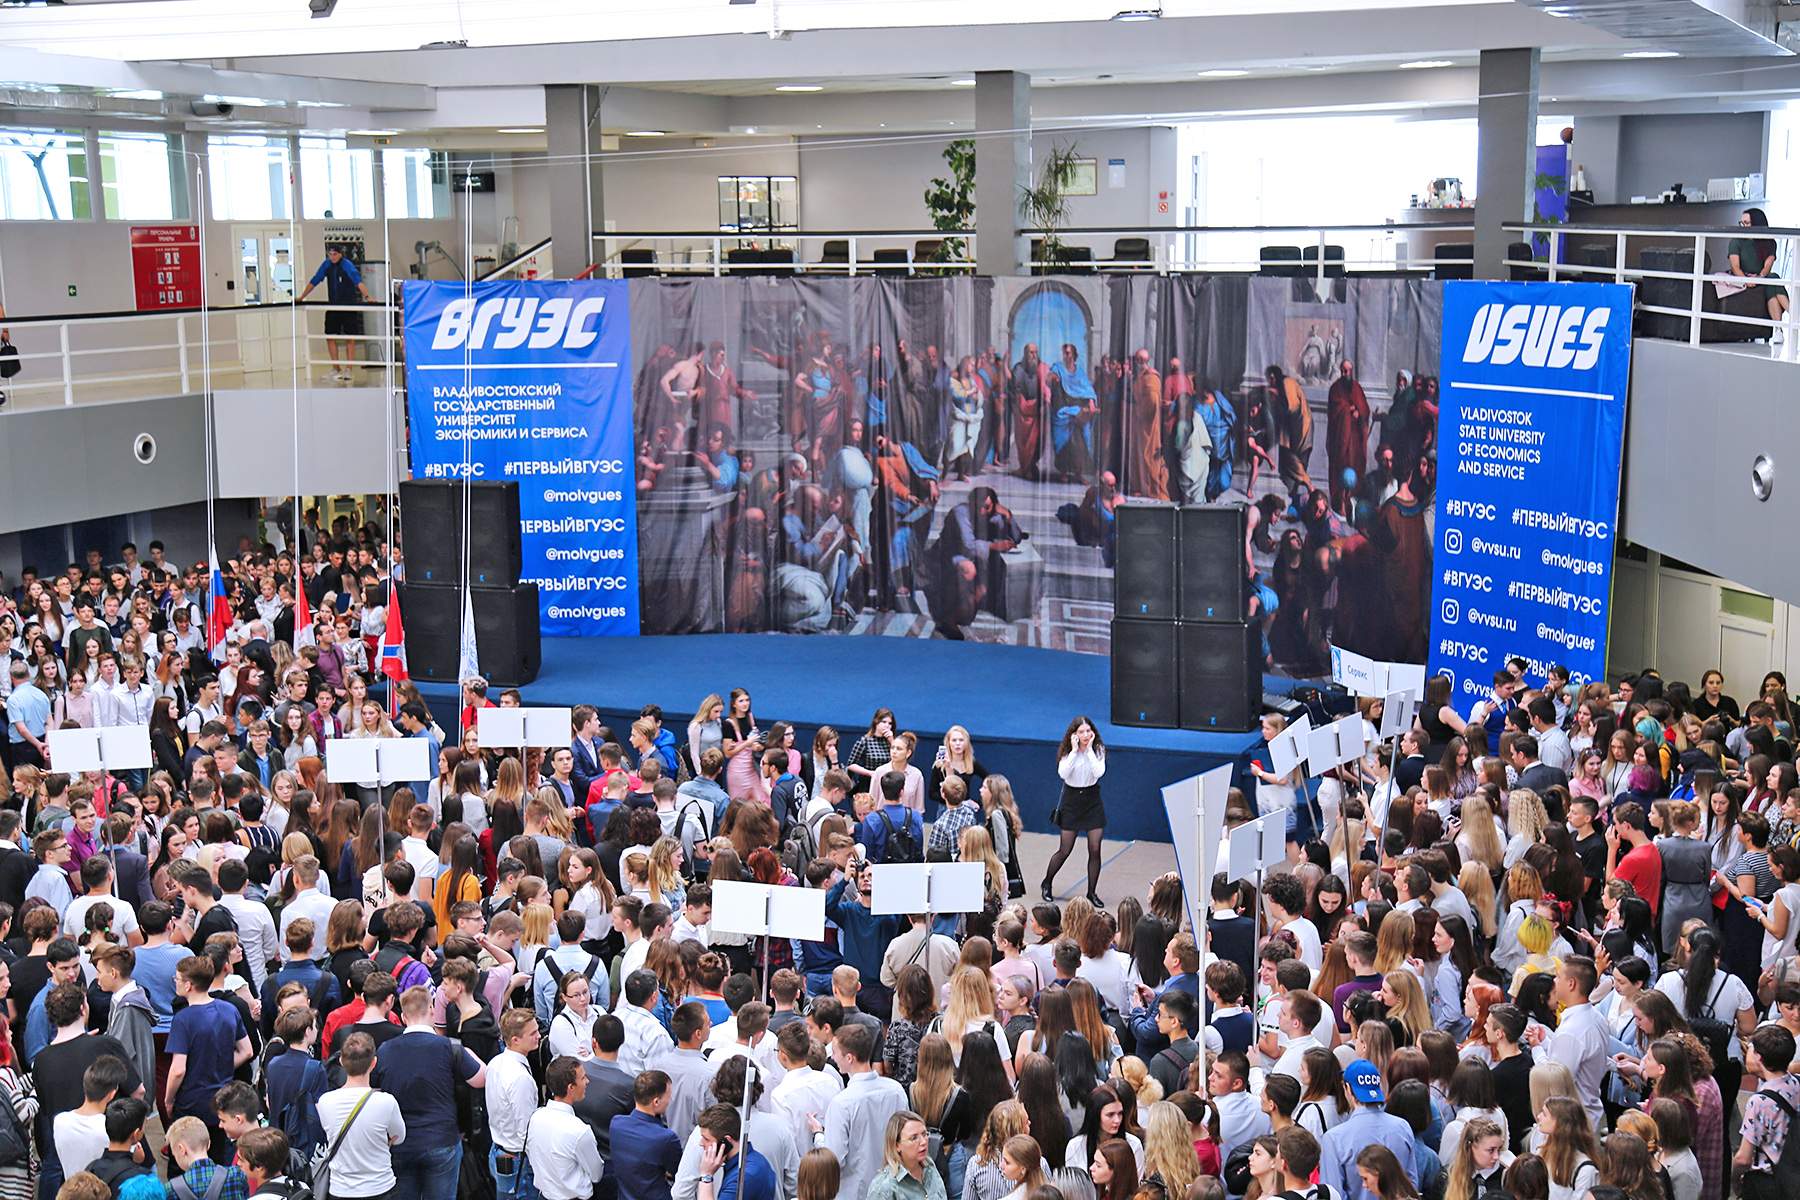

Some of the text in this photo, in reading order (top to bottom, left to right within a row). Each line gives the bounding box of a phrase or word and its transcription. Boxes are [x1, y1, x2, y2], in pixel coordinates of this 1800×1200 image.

[431, 297, 605, 350] ВГУЭС
[1462, 303, 1611, 371] USUES
[433, 383, 562, 398] ВЛАДИВОСТОКСКИЙ
[434, 398, 555, 413] ГОСУДАРСТВЕННЫЙ
[435, 414, 516, 426] УНИВЕРСИТЕТ
[1460, 406, 1532, 426] VLADIVOSTOK
[435, 427, 588, 440] ЭКОНОМИКИ И СЕРВИСА
[1459, 425, 1546, 446] STATE UNIVERSITY
[1458, 442, 1541, 464] OF ECONOMICS
[425, 458, 623, 477] #ВГУЭС #ПЕРВЫЙВГУЭС
[1458, 460, 1525, 480] AND SERVICE
[543, 489, 623, 504] @molvgues
[1446, 499, 1608, 540] #ВГУЭС #ПЕРВЫЙВГУЭС
[546, 548, 625, 562] @molvgues
[1471, 537, 1521, 559] @vvsu.ru
[1443, 569, 1602, 616] #ВГУЭС #ПЕРВЫЙВГУЭС
[548, 606, 626, 620] @molvgues
[1467, 608, 1517, 632] @vvsu.ru
[1440, 639, 1488, 663] #ВГУЭС
